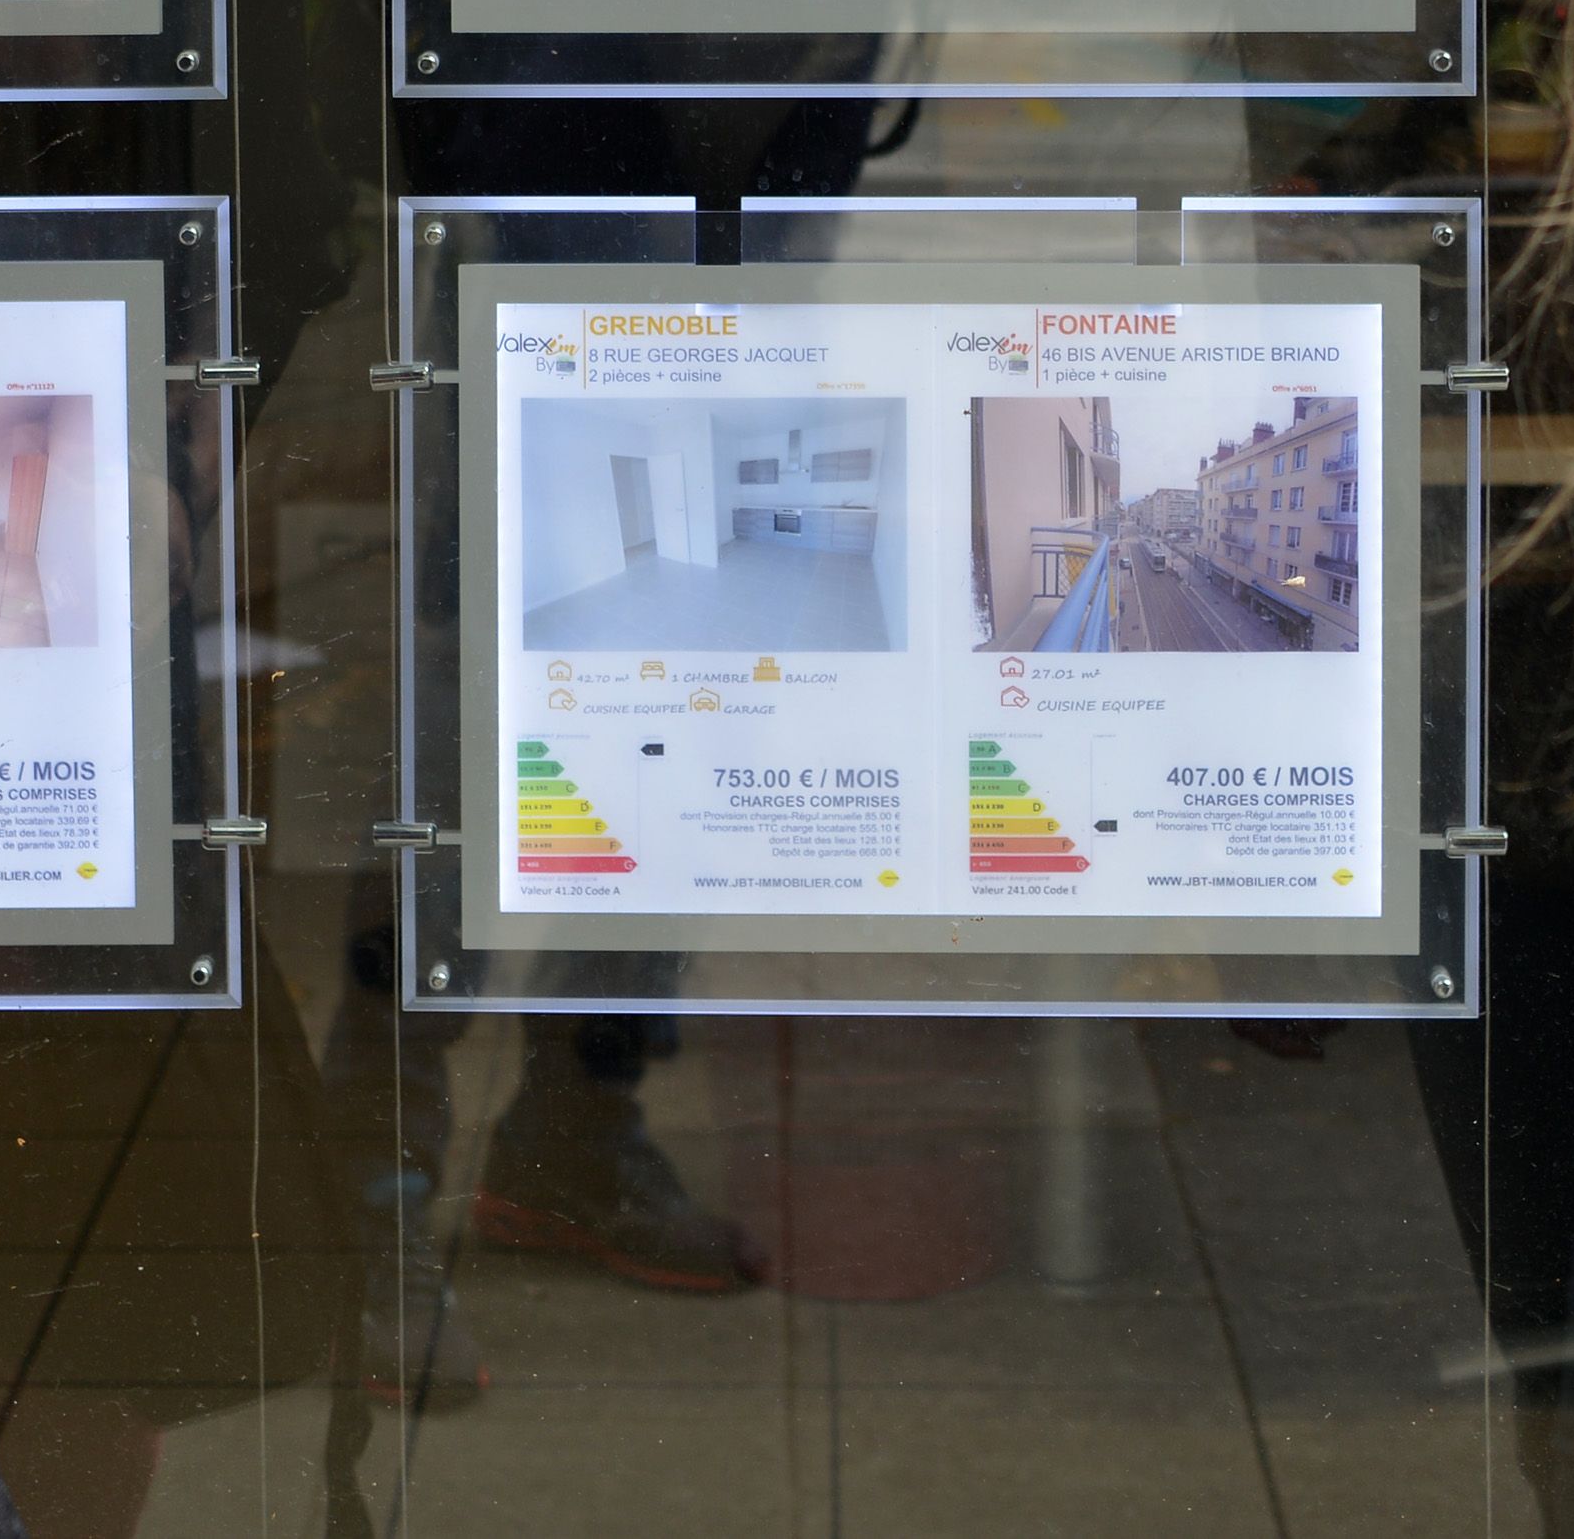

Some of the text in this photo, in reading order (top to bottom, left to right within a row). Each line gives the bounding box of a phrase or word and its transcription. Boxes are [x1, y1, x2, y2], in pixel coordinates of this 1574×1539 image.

[589, 315, 737, 336] GRENOBLE
[1042, 313, 1176, 335] FONTAINE
[588, 347, 829, 363] 8 RUE GEORGES JACQUET
[1041, 346, 1340, 362] 46 BIS AVENUE ARISTIDE BRIAND
[1036, 699, 1166, 714] CUISINE EQUIPEE
[33, 761, 96, 781] MOIS
[713, 768, 791, 788] 753.00
[799, 768, 813, 788] €
[835, 768, 899, 788] MOIS
[1166, 766, 1244, 787] 407.00
[1252, 767, 1267, 787] €
[1289, 766, 1354, 787] MOIS
[7, 787, 97, 801] COMPRISES
